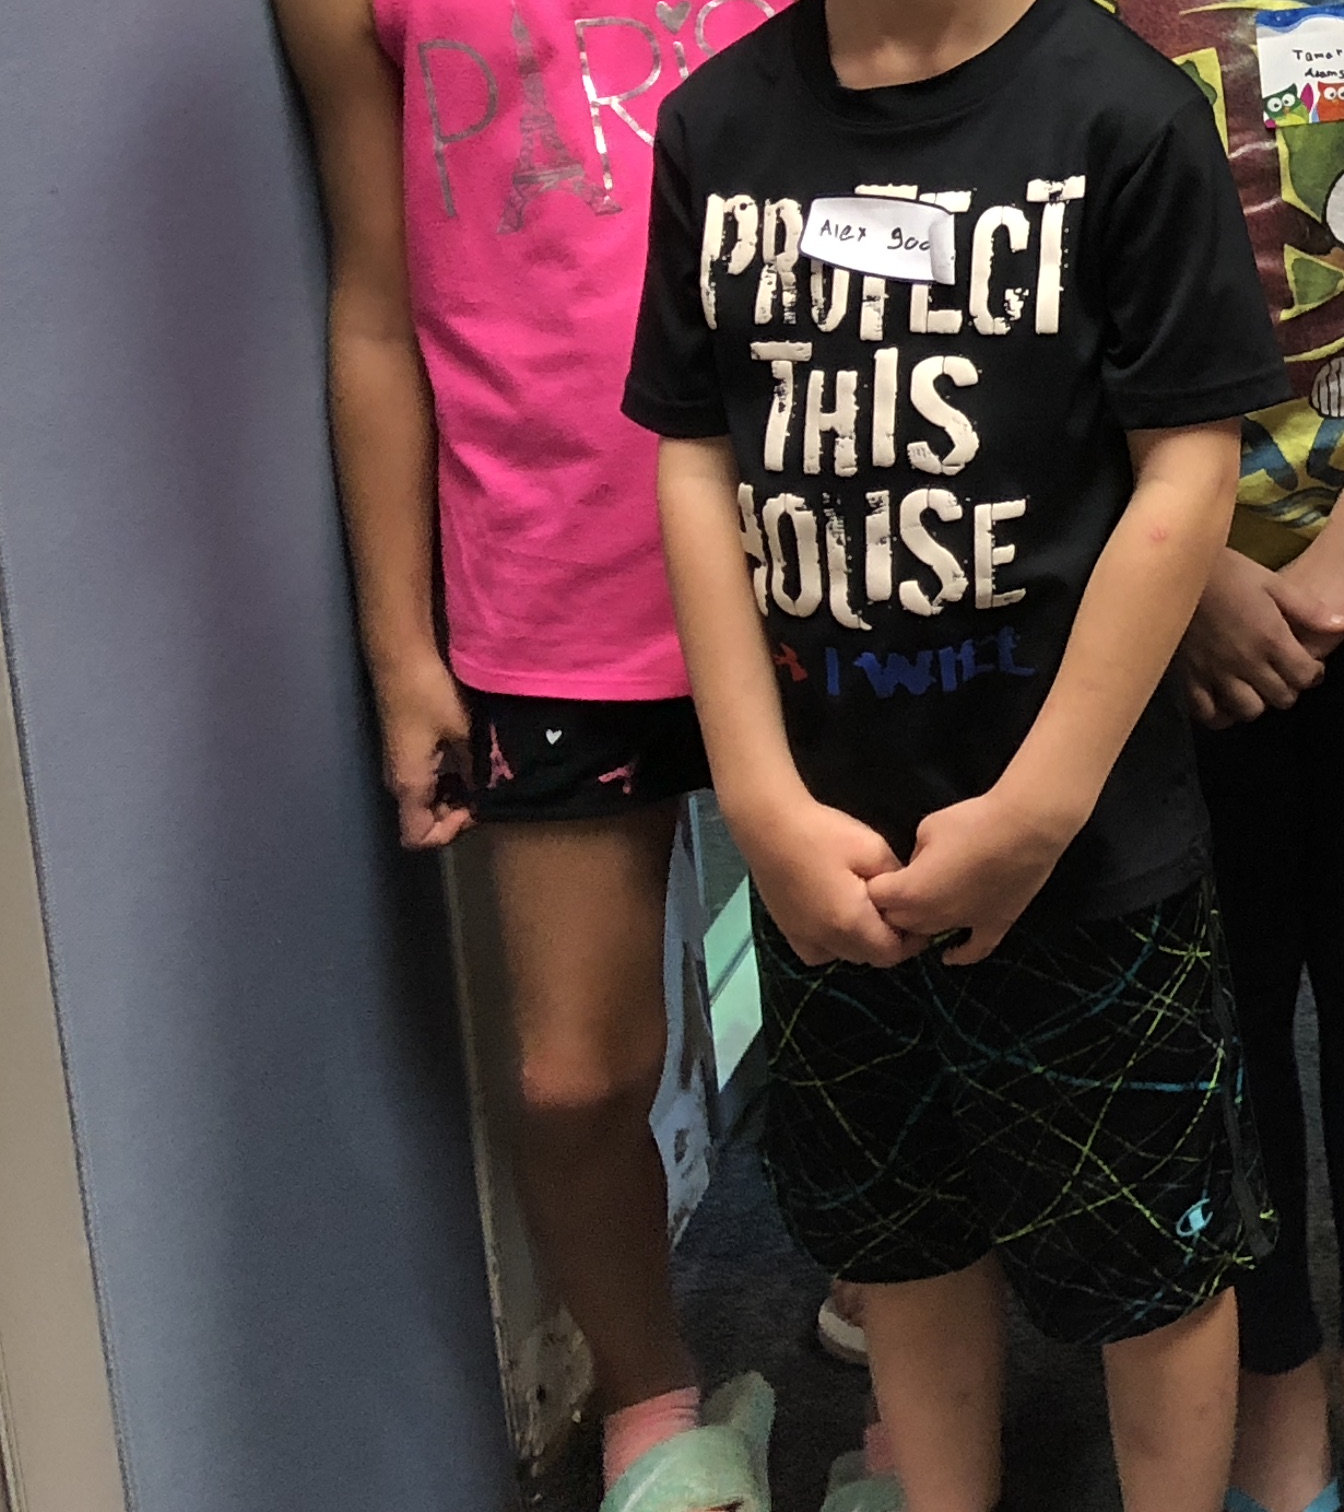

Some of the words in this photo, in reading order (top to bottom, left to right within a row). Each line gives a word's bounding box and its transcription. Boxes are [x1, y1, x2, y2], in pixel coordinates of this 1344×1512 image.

[750, 339, 980, 477] THIS
[824, 647, 841, 697] I
[853, 626, 1038, 699] WILL
